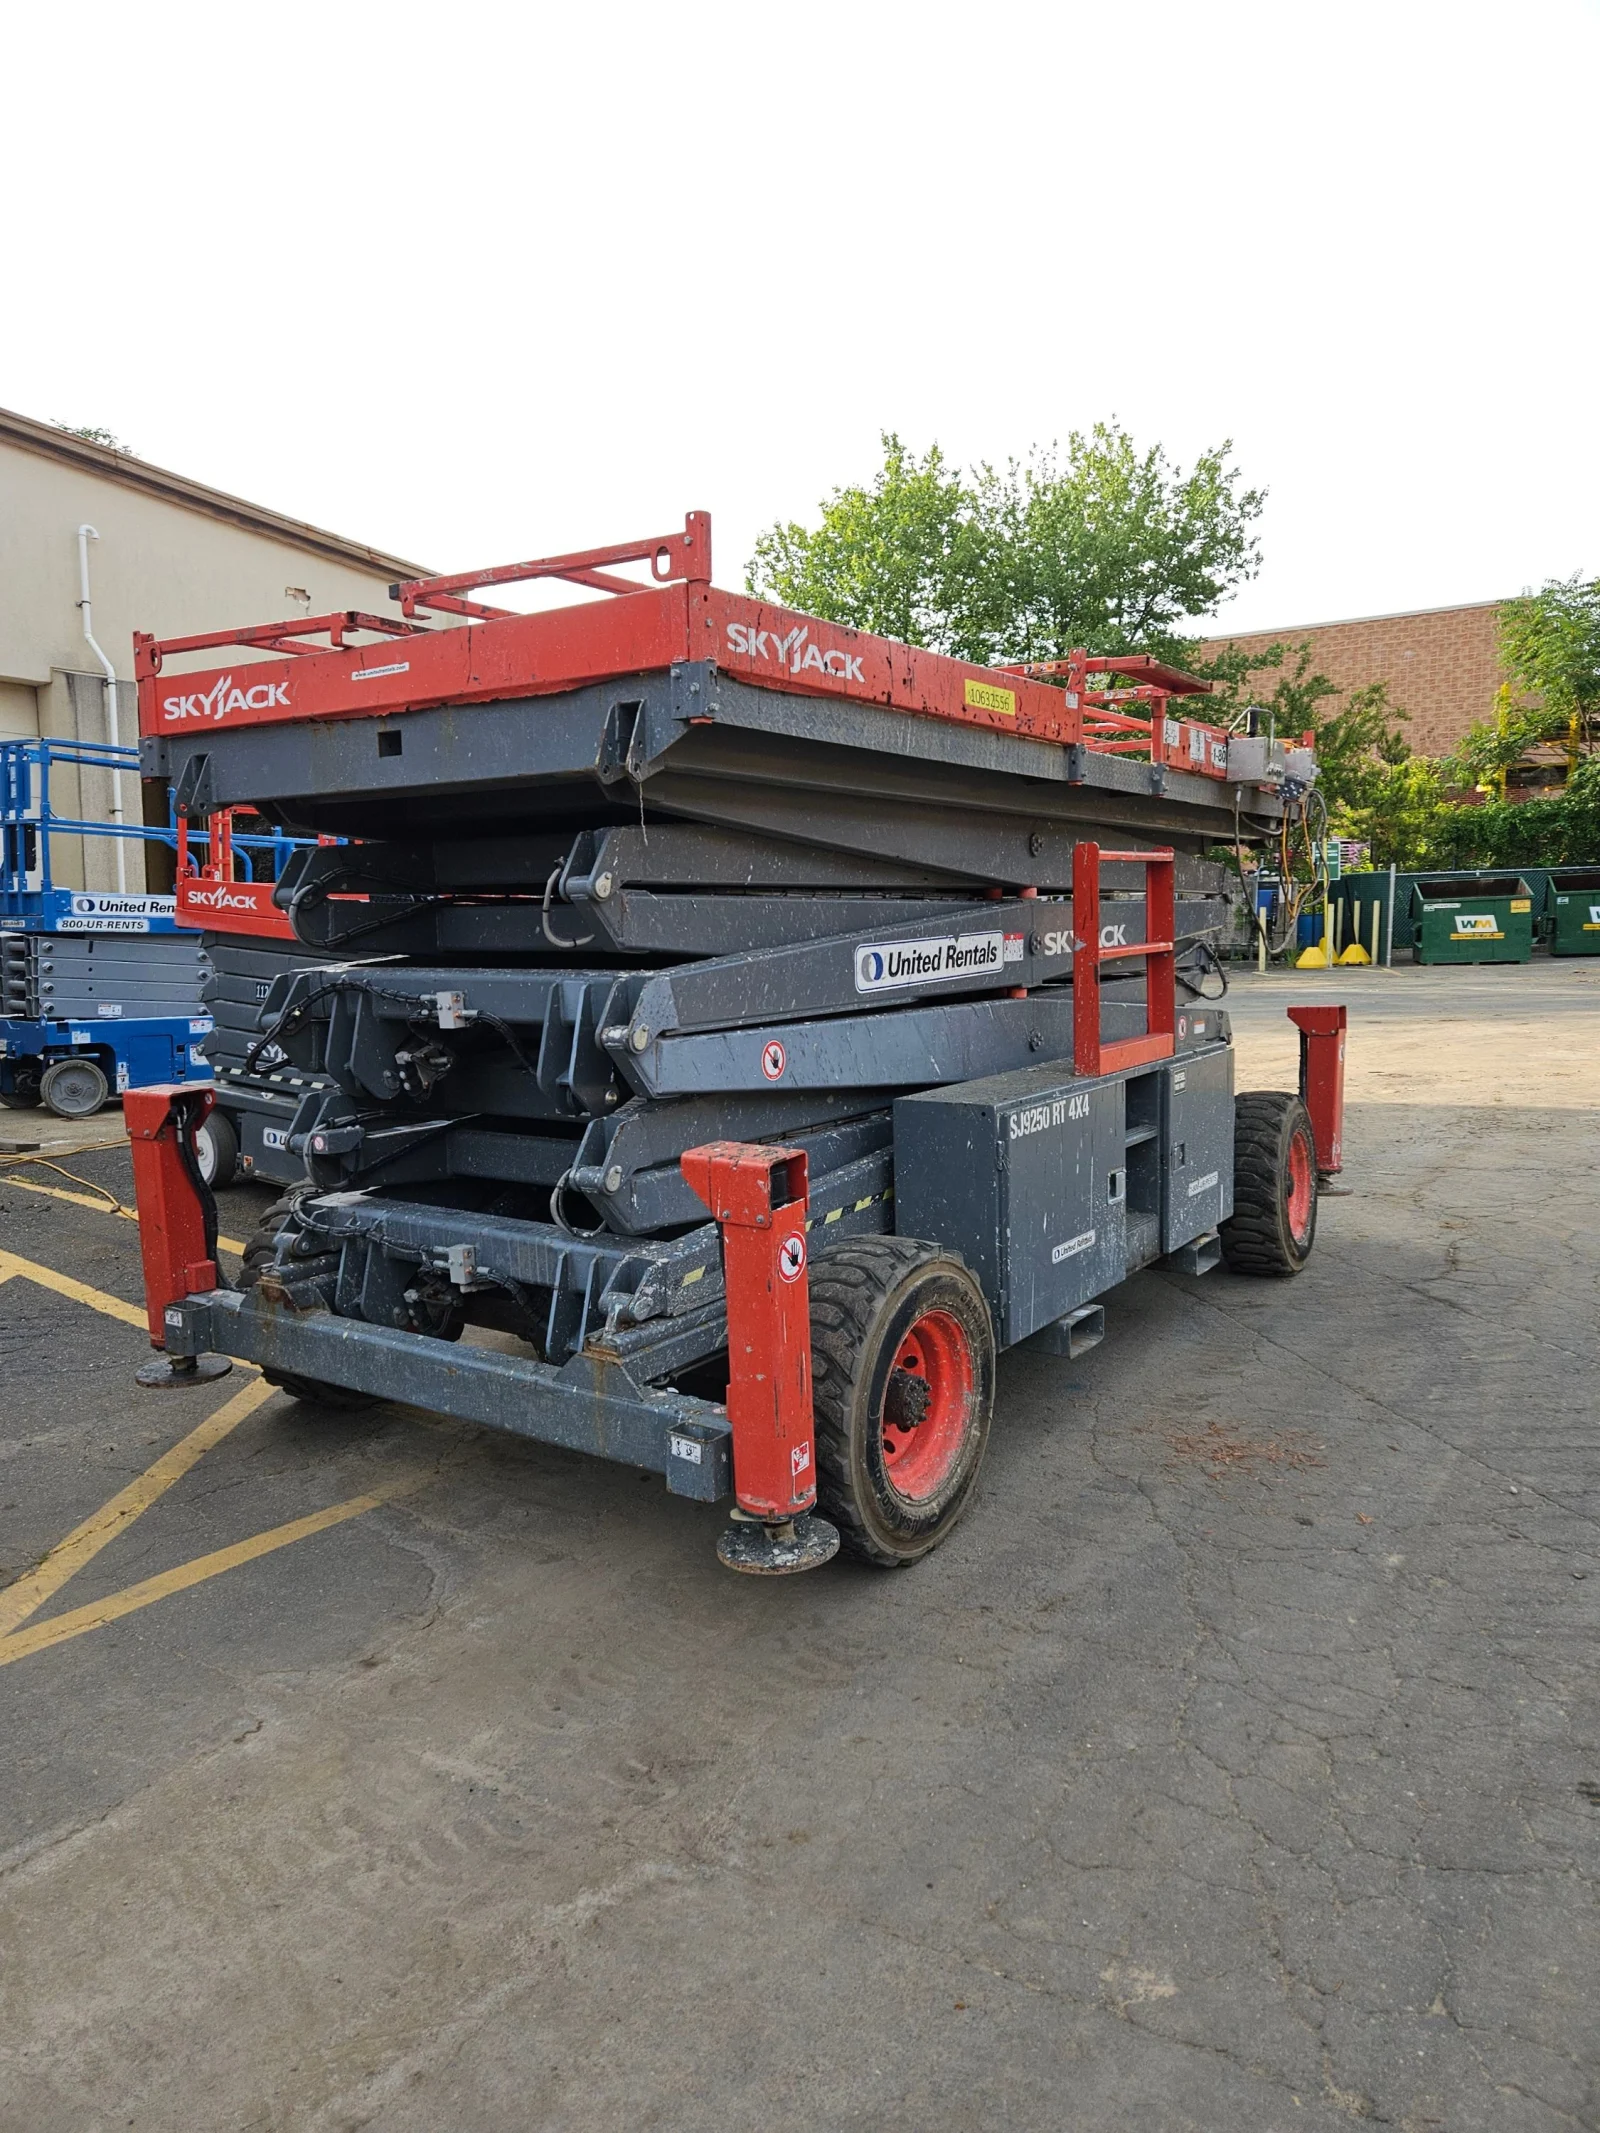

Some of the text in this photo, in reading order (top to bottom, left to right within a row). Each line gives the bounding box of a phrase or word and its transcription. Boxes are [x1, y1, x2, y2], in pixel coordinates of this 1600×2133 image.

[726, 623, 866, 683] SKYJACK
[163, 675, 291, 720] SKYJACK
[970, 688, 1010, 711] 10632556
[99, 900, 146, 913] United
[187, 886, 257, 909] SKYJACK
[61, 919, 145, 930] 800-UR-RENTS
[1461, 919, 1493, 929] WM
[888, 946, 944, 978] United
[945, 940, 998, 969] Rentals
[1009, 1093, 1090, 1140] SJ9250 RT 4X4
